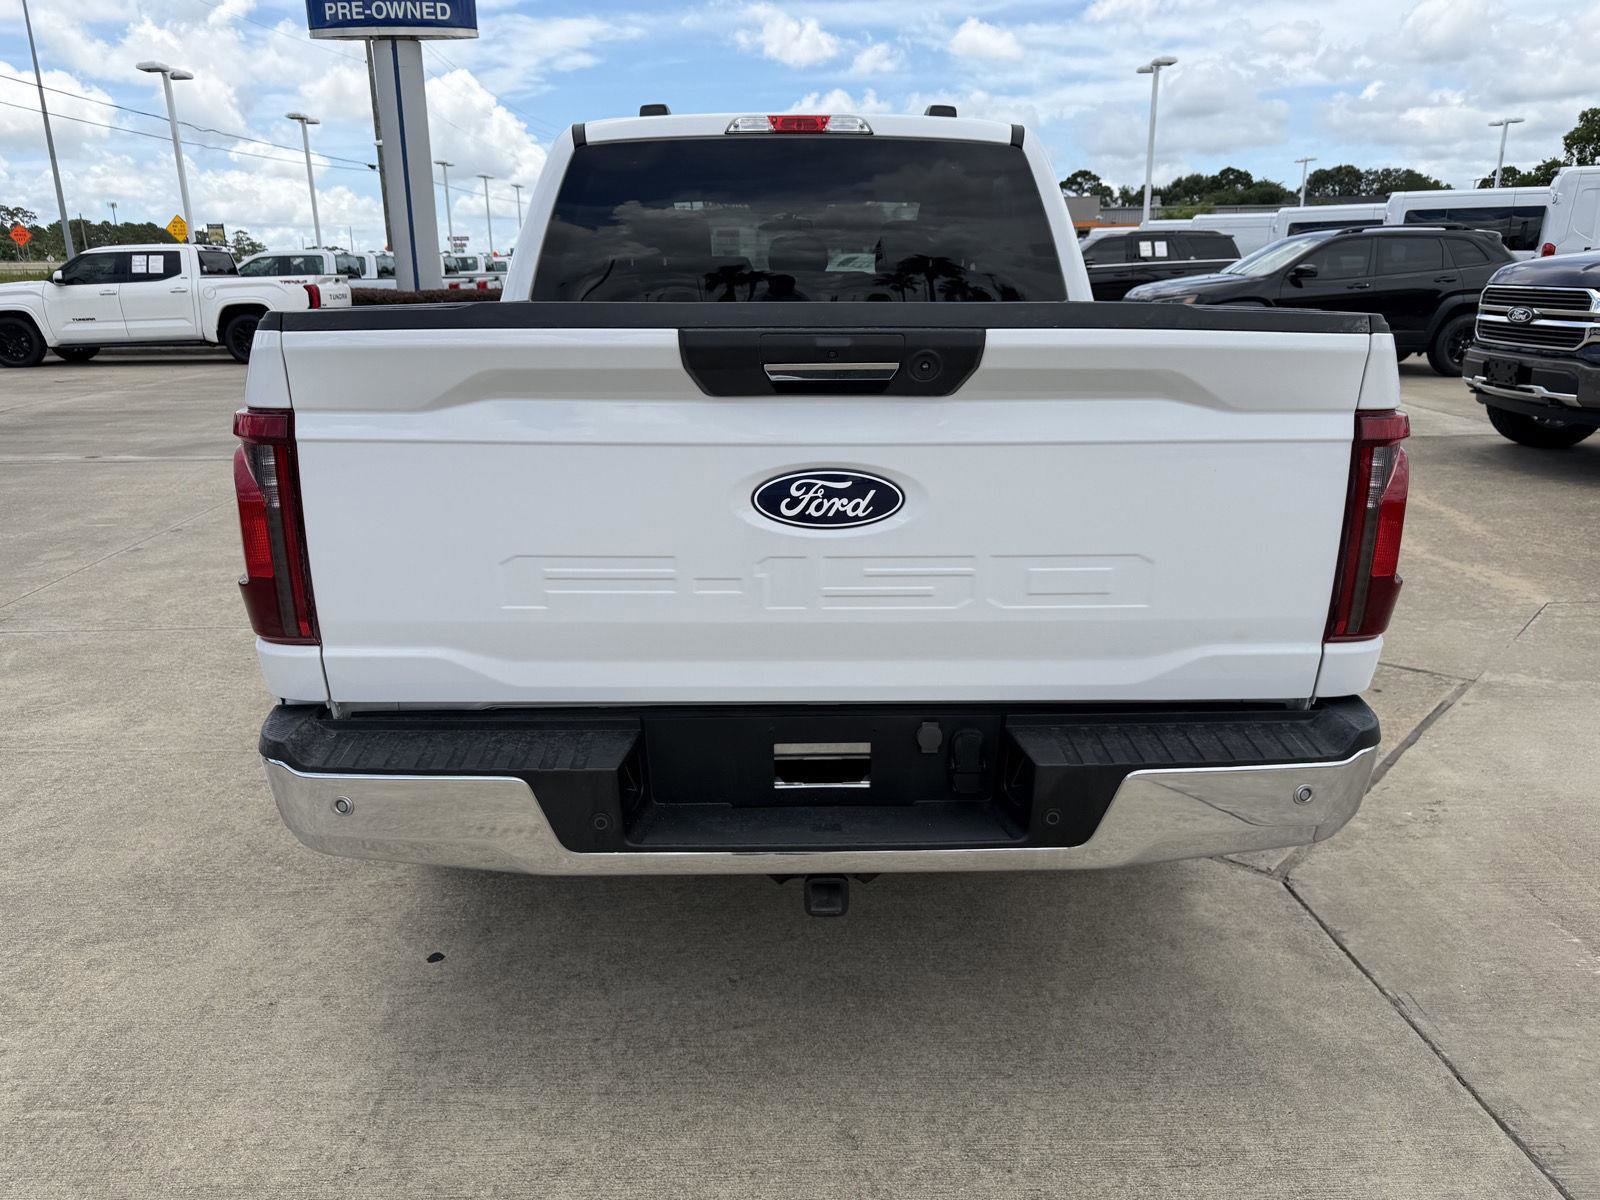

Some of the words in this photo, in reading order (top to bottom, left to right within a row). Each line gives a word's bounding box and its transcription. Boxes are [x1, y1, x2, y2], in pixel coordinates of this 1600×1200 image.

[323, 2, 451, 20] PRE-OWNED
[780, 479, 877, 517] Ford
[500, 553, 1155, 610] F-150
